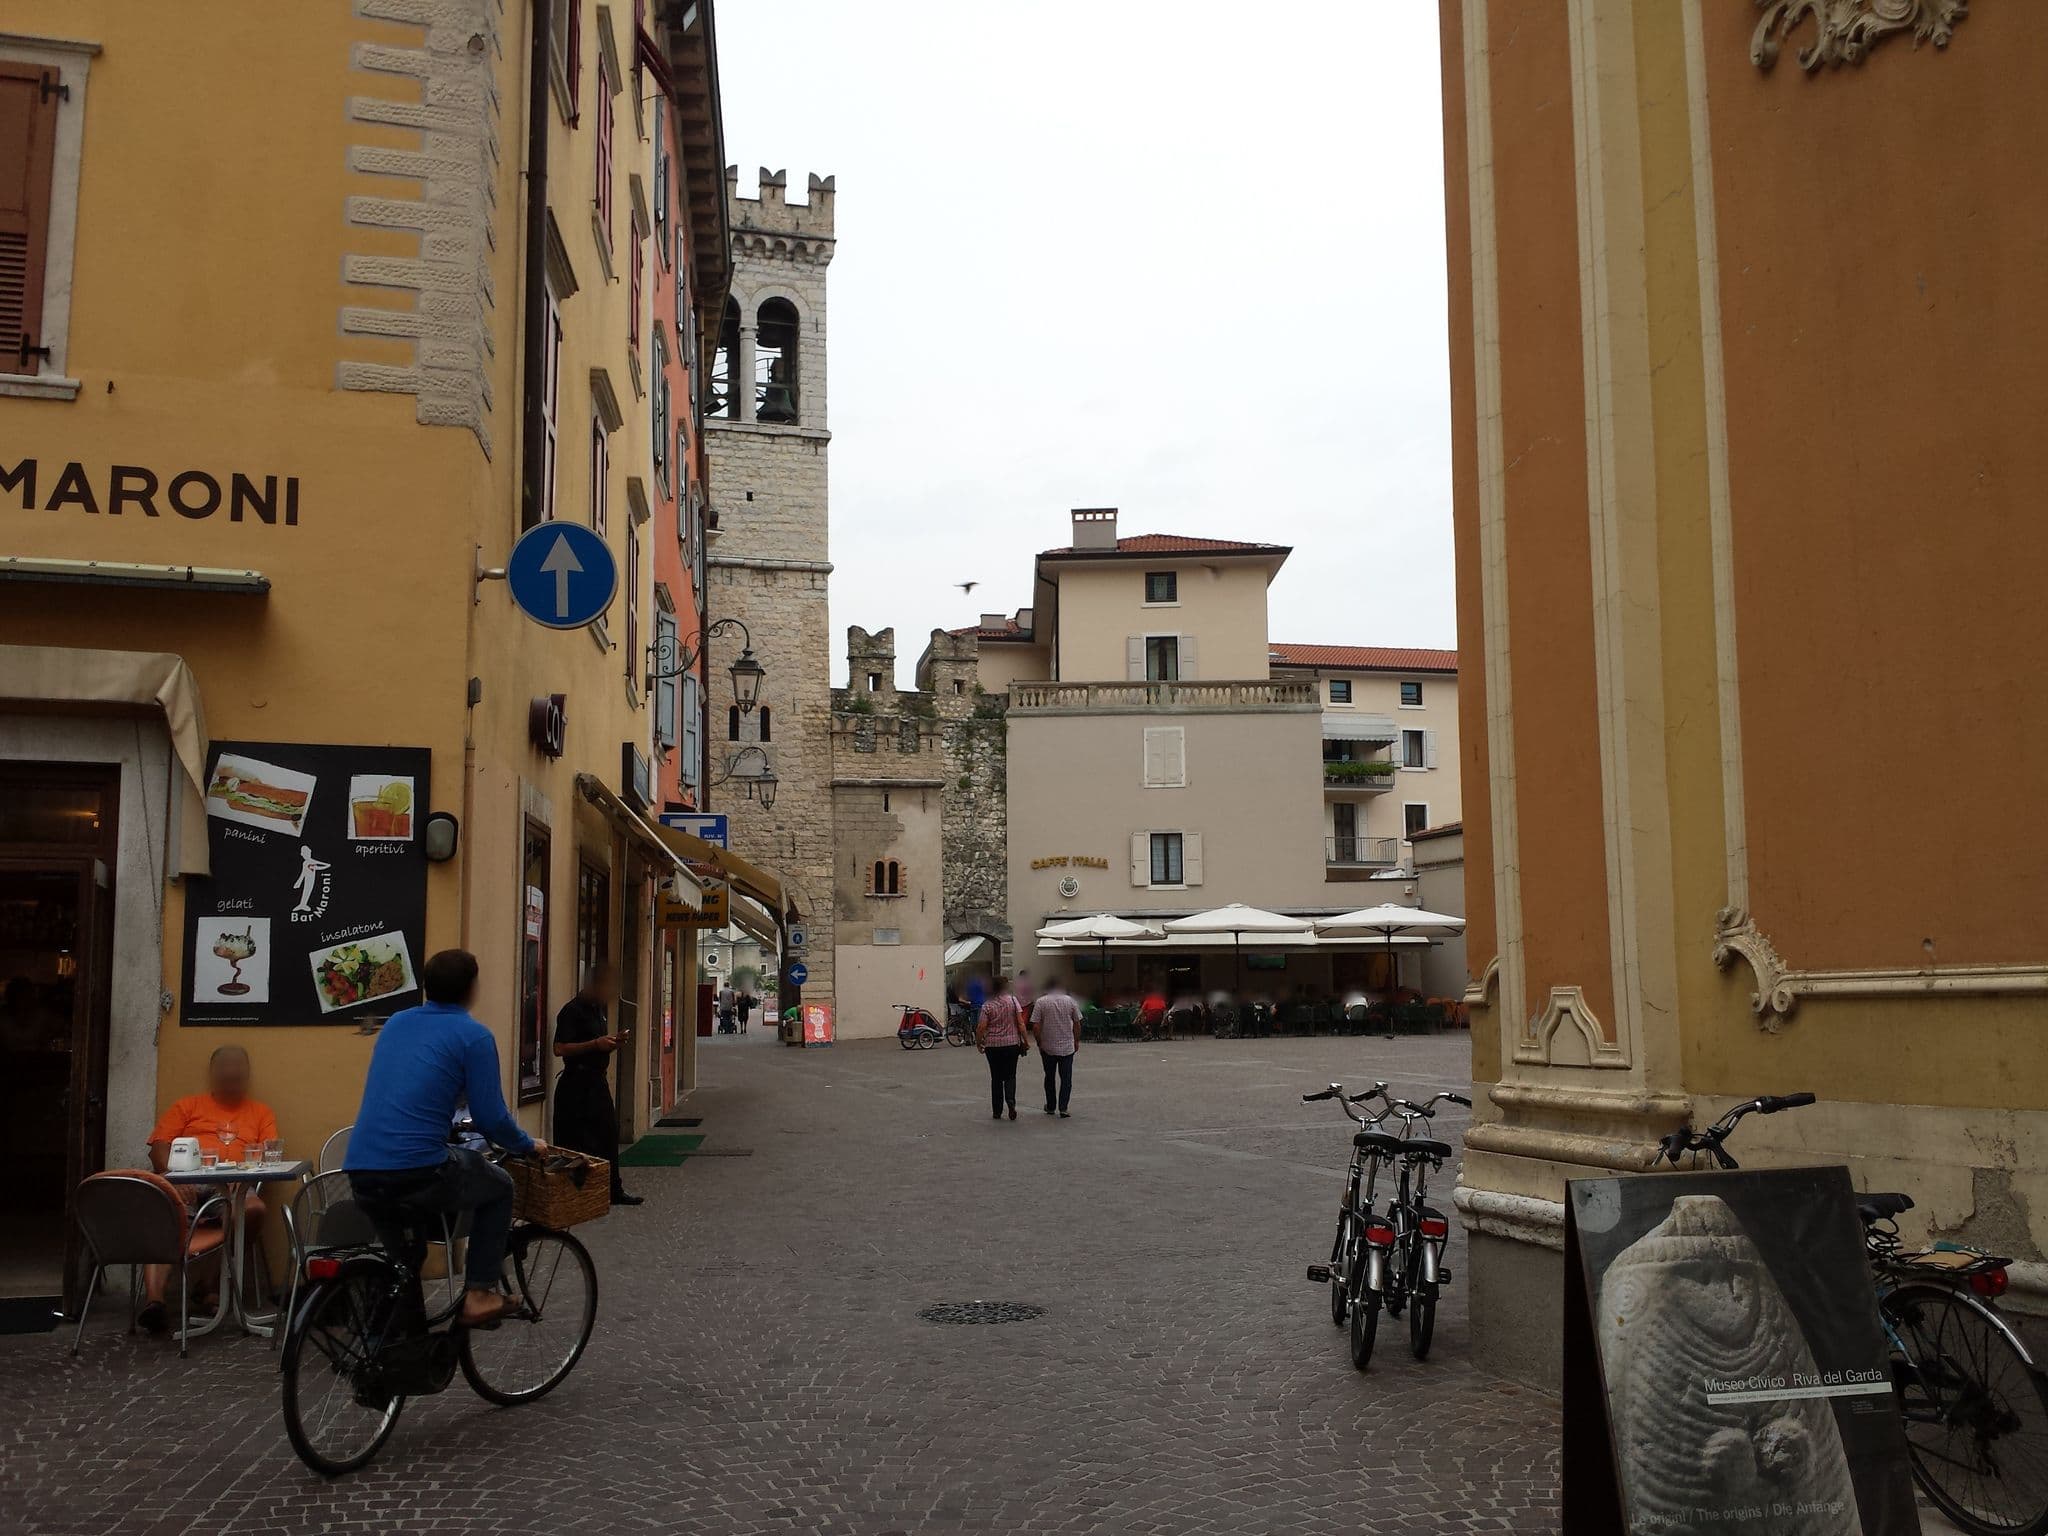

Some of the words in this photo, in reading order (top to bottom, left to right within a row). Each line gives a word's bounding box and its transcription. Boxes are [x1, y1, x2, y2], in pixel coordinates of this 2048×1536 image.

[0, 459, 299, 526] MARONI
[224, 827, 267, 844] panini
[355, 843, 406, 858] aperitivi
[1072, 856, 1108, 869] ITALIA
[217, 897, 254, 912] gelati
[290, 912, 314, 922] Bar
[313, 872, 332, 919] Maroni
[320, 920, 385, 943] insalatone
[1704, 1378, 1745, 1392] Museo
[1748, 1375, 1786, 1389] Civico
[1793, 1373, 1820, 1386] Riva
[1823, 1370, 1843, 1384] del
[1846, 1368, 1883, 1382] Garda
[1650, 1509, 1686, 1527] origini
[1696, 1508, 1719, 1521] The
[1723, 1504, 1762, 1521] origins
[1772, 1503, 1793, 1516] Die
